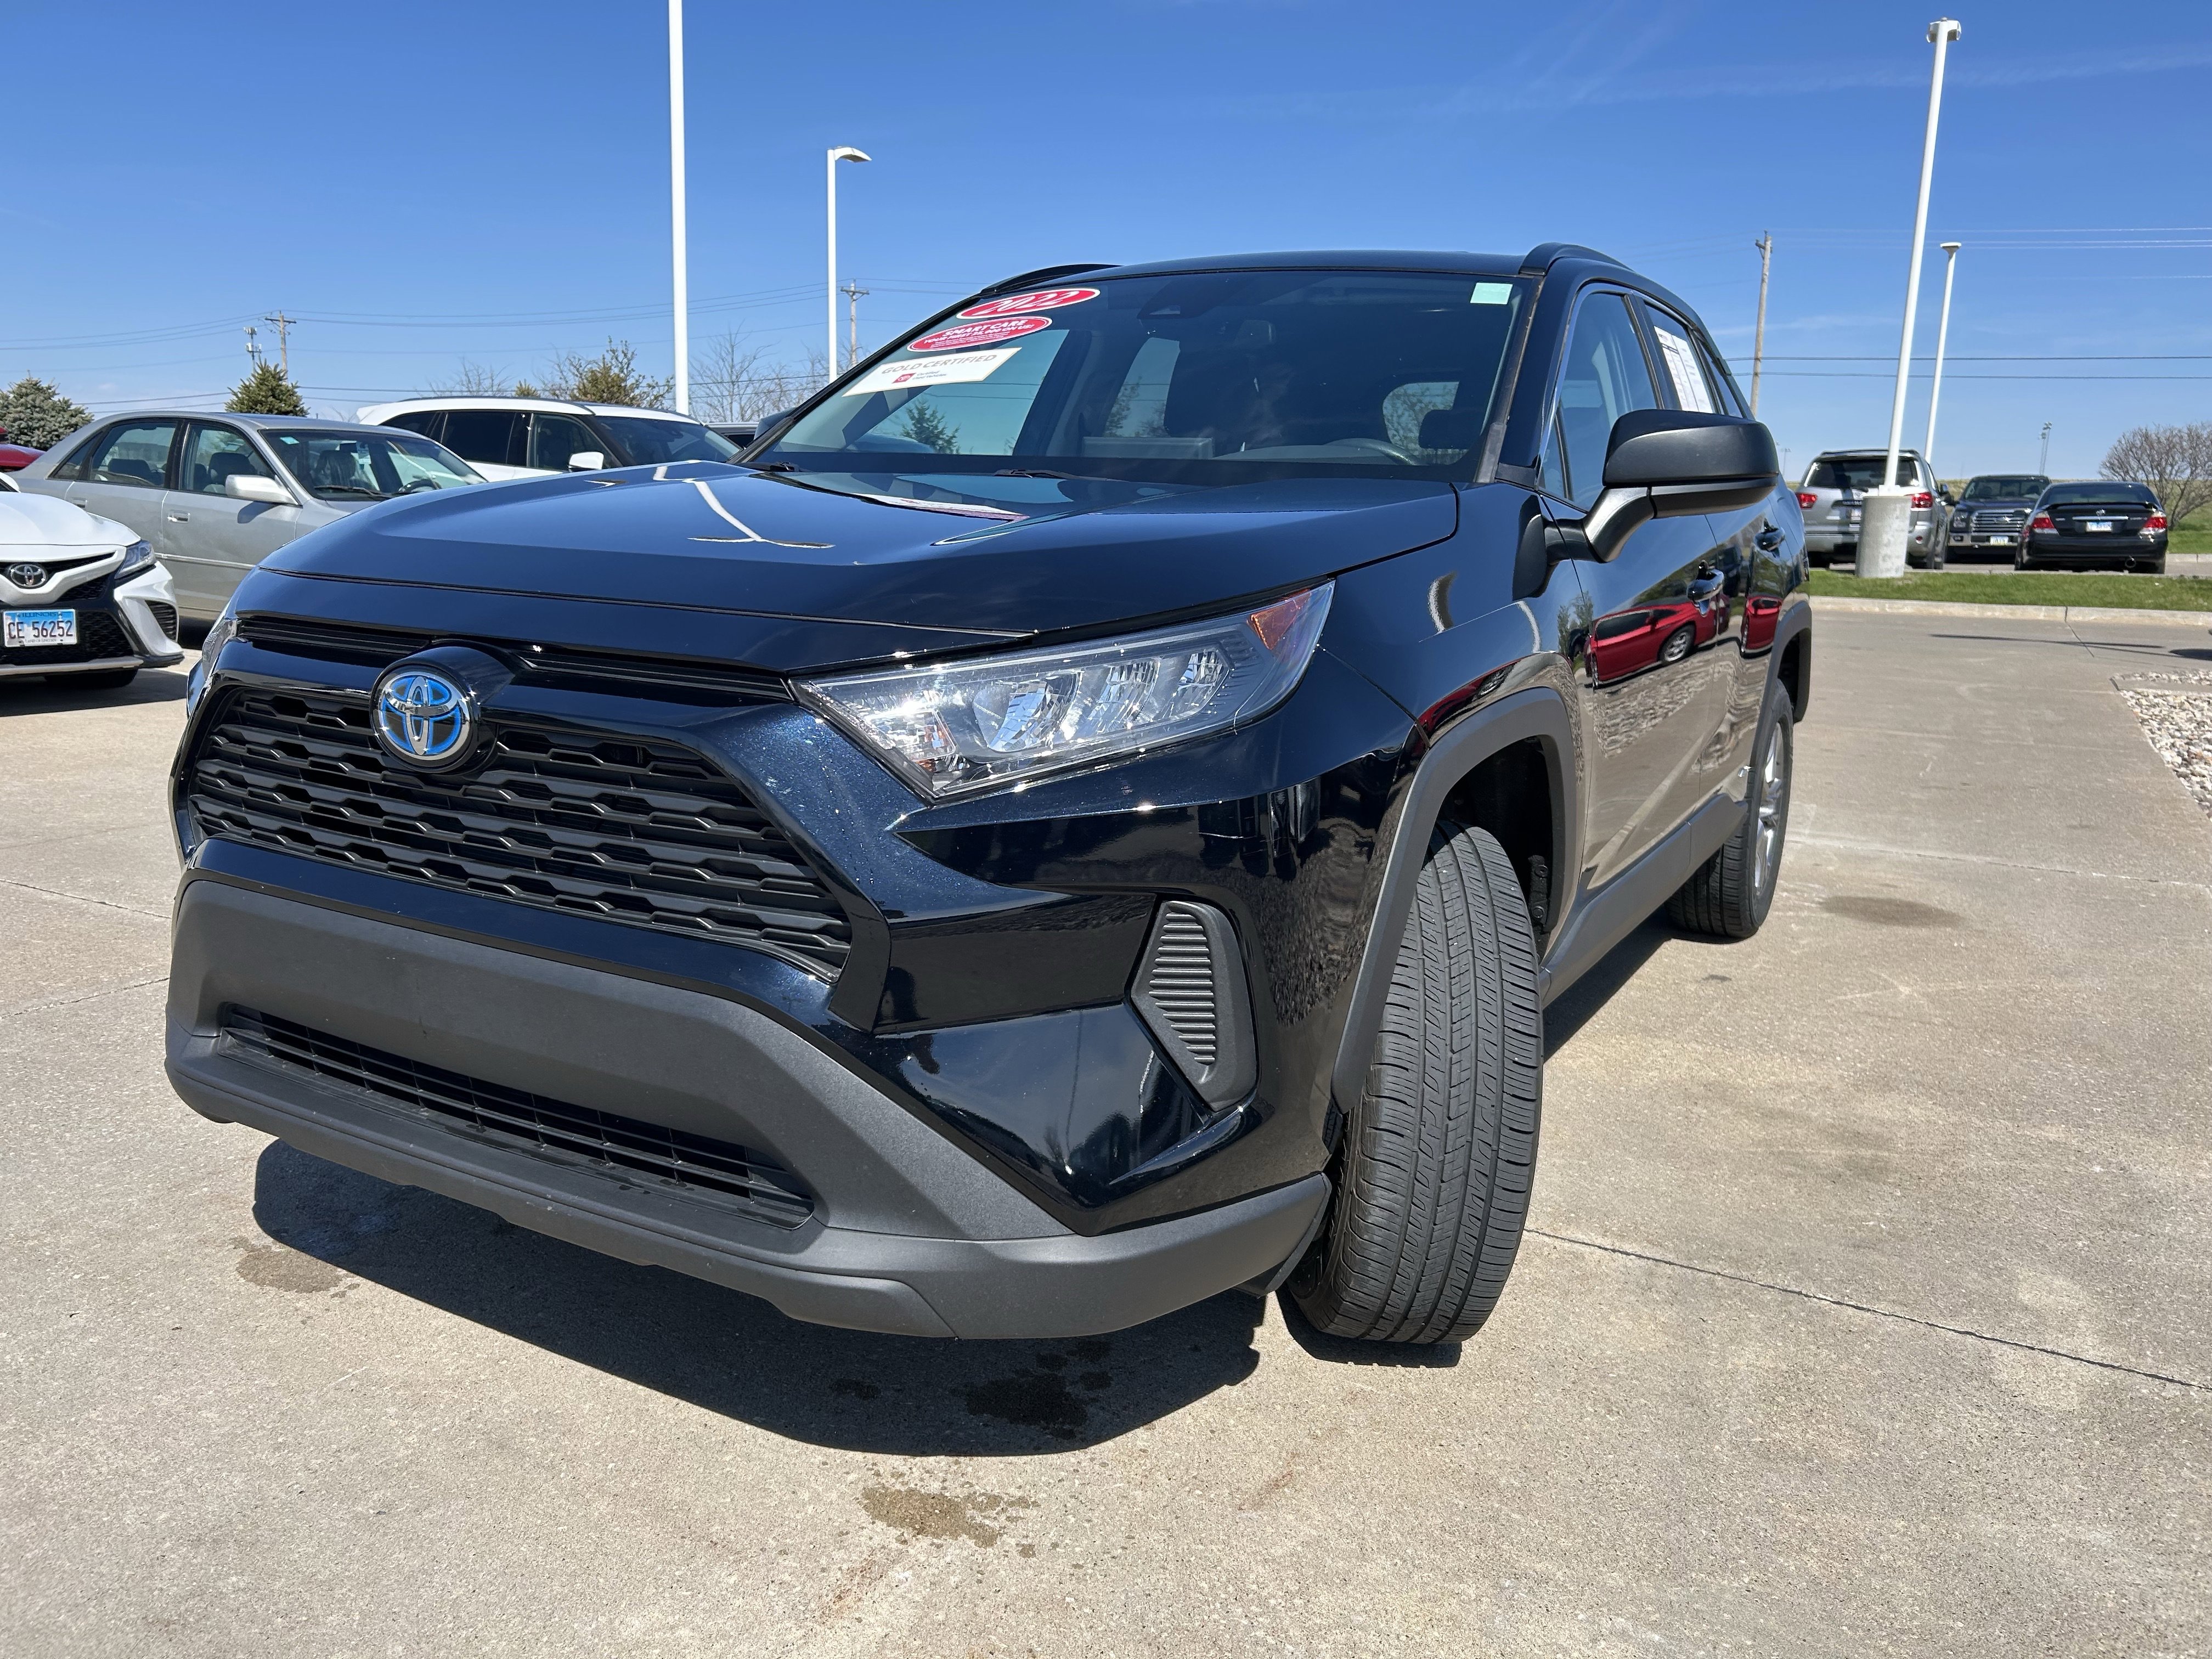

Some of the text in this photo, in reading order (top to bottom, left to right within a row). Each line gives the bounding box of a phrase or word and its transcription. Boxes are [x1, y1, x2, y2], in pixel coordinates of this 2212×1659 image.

[970, 290, 1080, 316] 2022
[942, 319, 1029, 337] SMART CARE
[881, 354, 997, 374] GOLD CERTIFIED
[8, 620, 73, 639] CE 56252
